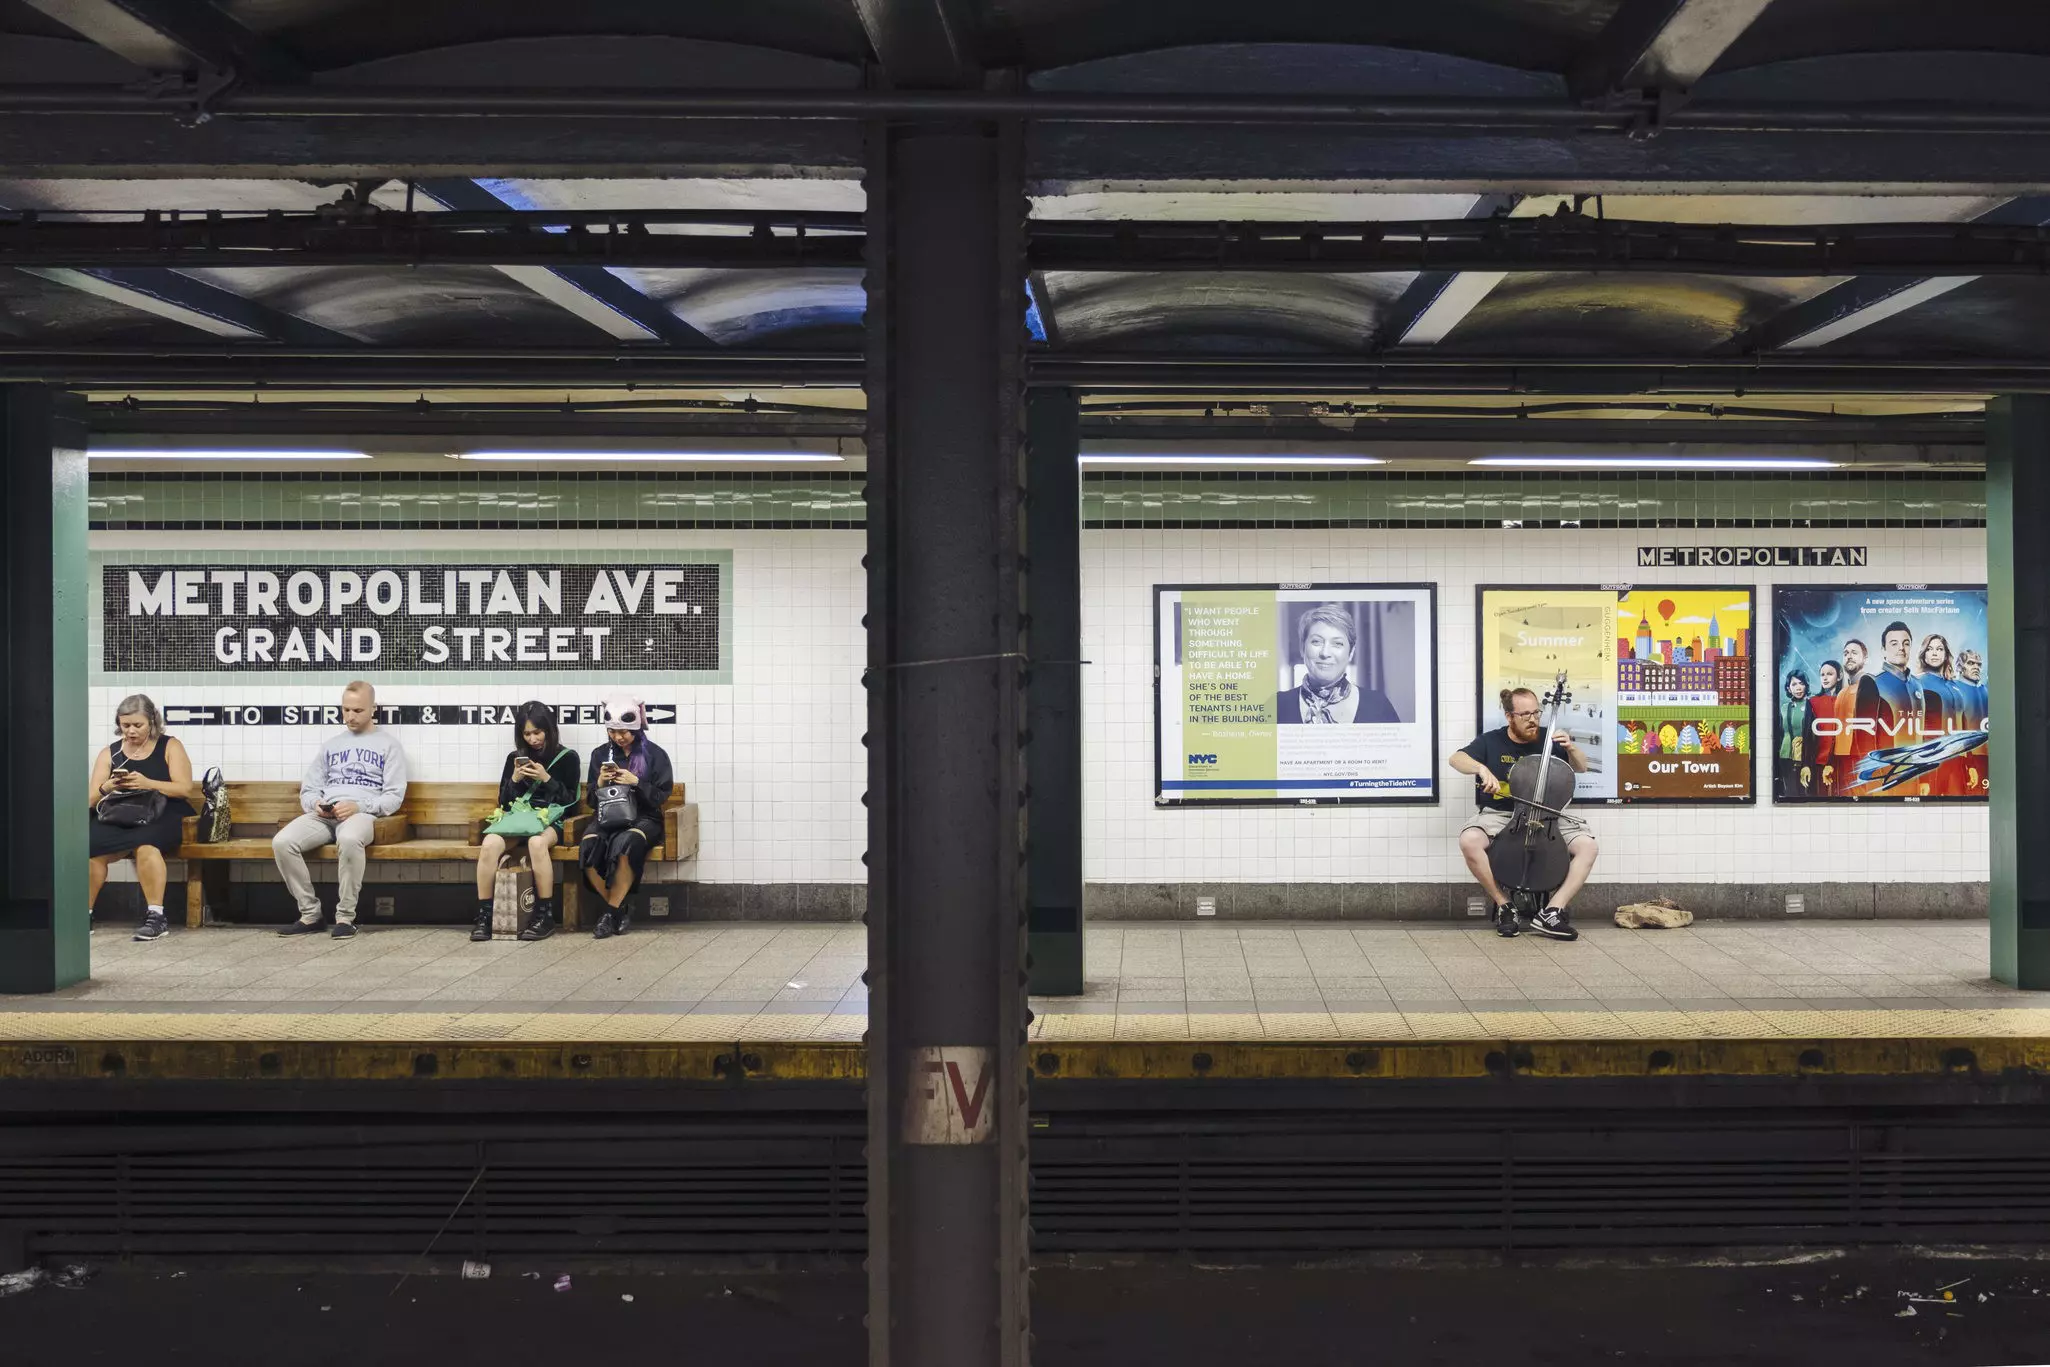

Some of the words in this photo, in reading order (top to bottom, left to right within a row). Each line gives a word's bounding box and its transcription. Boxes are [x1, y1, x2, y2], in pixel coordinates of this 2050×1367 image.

[1639, 547, 1868, 566] METROPOLITAN
[128, 569, 562, 616] METROPOLITAN
[583, 569, 702, 615] AVE.
[1194, 607, 1222, 615] WANT
[1224, 607, 1259, 615] PEOPLE
[1860, 606, 1877, 614] from
[1878, 606, 1902, 614] creator
[1903, 606, 1919, 614] Seth
[1920, 606, 1960, 614] MacFarlane
[1188, 618, 1211, 626] WHO
[1213, 618, 1240, 626] WENT
[1516, 630, 1585, 647] Summer
[214, 626, 382, 663] GRAND
[421, 625, 611, 663] STREET
[1188, 650, 1235, 658] DIFFICULT
[1237, 650, 1247, 658] IN
[1249, 650, 1269, 658] LIFE
[1189, 661, 1201, 669] TO
[1204, 661, 1216, 669] BE
[1218, 661, 1242, 669] ABLE
[1245, 661, 1257, 669] TO
[1189, 672, 1214, 680] HAVE
[1216, 672, 1223, 680] A
[1225, 672, 1254, 680] HOME.
[1189, 682, 1217, 690] SHE'S
[1219, 682, 1238, 690] ONE
[1189, 693, 1202, 701] OF
[1204, 693, 1222, 701] THE
[1224, 693, 1249, 701] BEST
[1189, 704, 1232, 712] TENANTS
[1240, 704, 1265, 712] HAVE
[224, 706, 262, 725] TO
[283, 706, 400, 725] STRT
[421, 706, 437, 724] &
[461, 706, 605, 725] TRAFE
[1189, 715, 1199, 723] IN
[1202, 715, 1219, 723] THE
[1811, 717, 1988, 737] ORVILL
[1188, 754, 1218, 764] NYC
[1648, 760, 1679, 774] Our
[1681, 760, 1720, 774] Town
[1349, 780, 1417, 788] #TurningtheTideNYC
